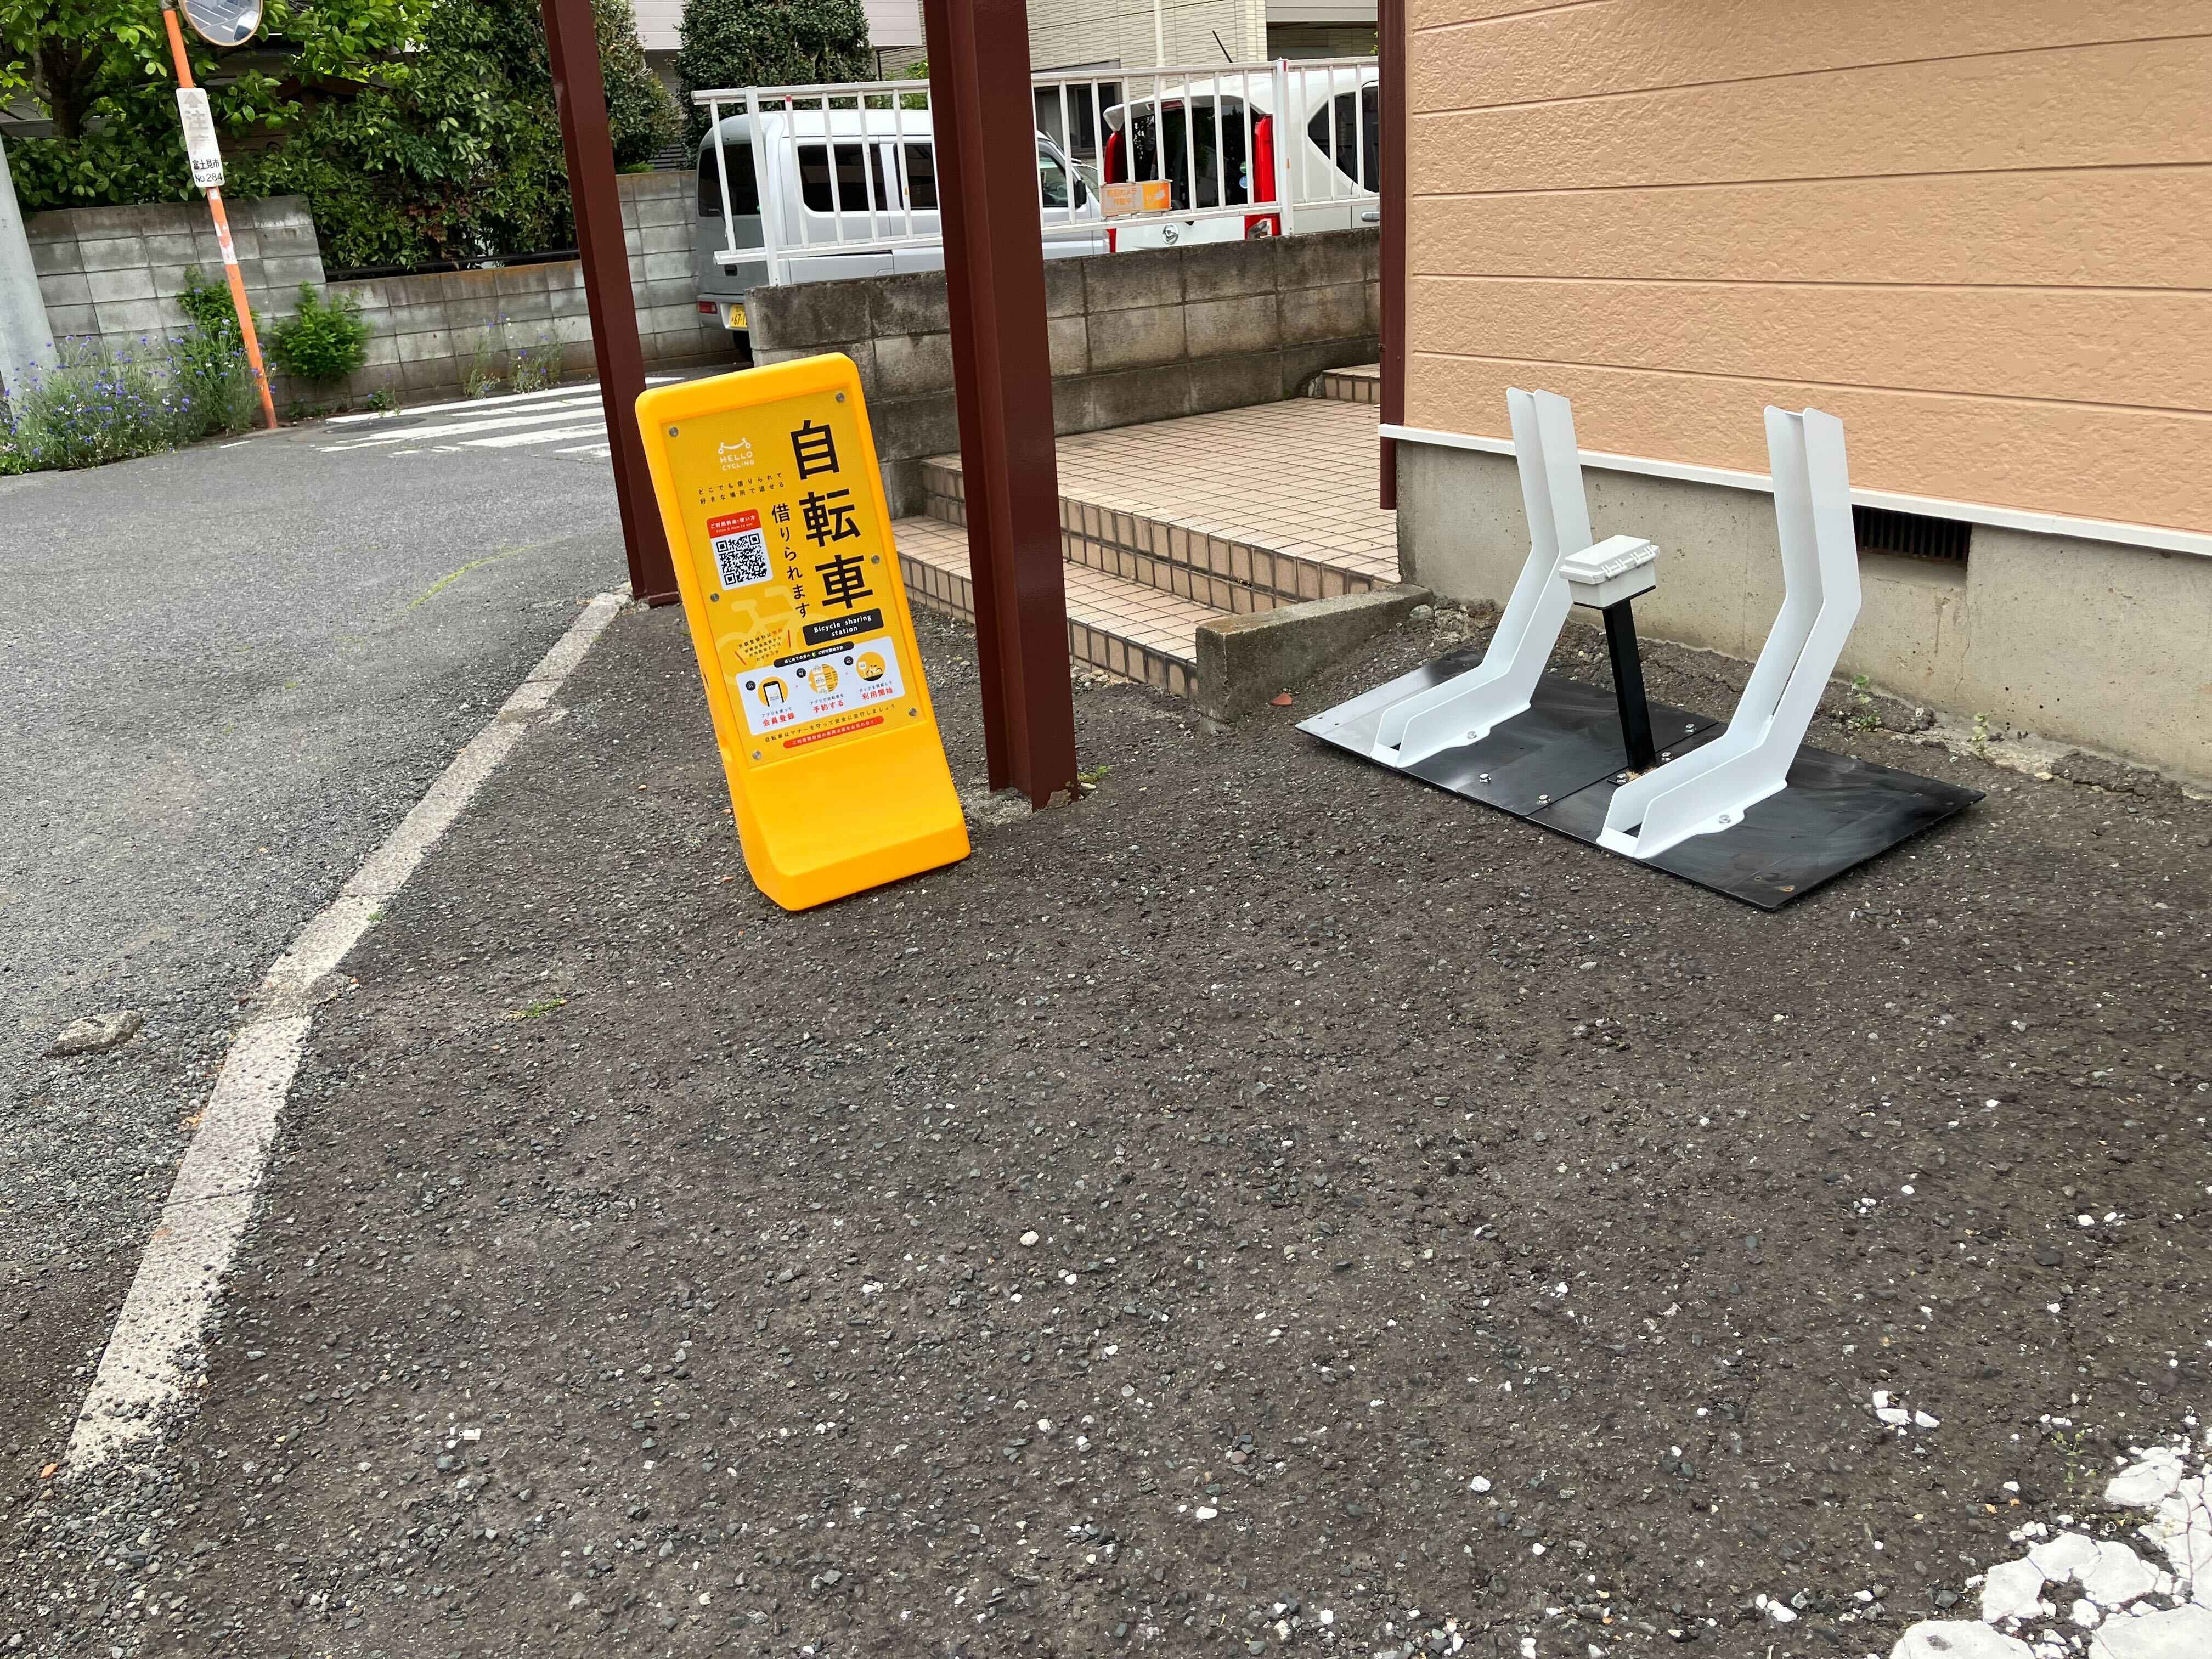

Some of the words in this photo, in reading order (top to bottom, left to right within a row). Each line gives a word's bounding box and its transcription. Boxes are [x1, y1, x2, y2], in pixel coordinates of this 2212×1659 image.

[192, 159, 219, 170] 富士見市
[720, 451, 753, 464] HELLO
[721, 460, 755, 471] CYCLING
[698, 472, 782, 495] どこでも借りられて
[700, 482, 784, 504] 好きな場所で返せる
[790, 420, 873, 609] 自転車
[771, 503, 810, 618] 借りられます
[813, 620, 840, 633] Bicycle
[845, 614, 872, 625] sharing
[831, 626, 858, 637] station
[784, 654, 810, 664] はじめての方へ
[862, 686, 893, 701] 利用開始
[812, 699, 844, 713] 予約する
[763, 712, 794, 726] 会員登録
